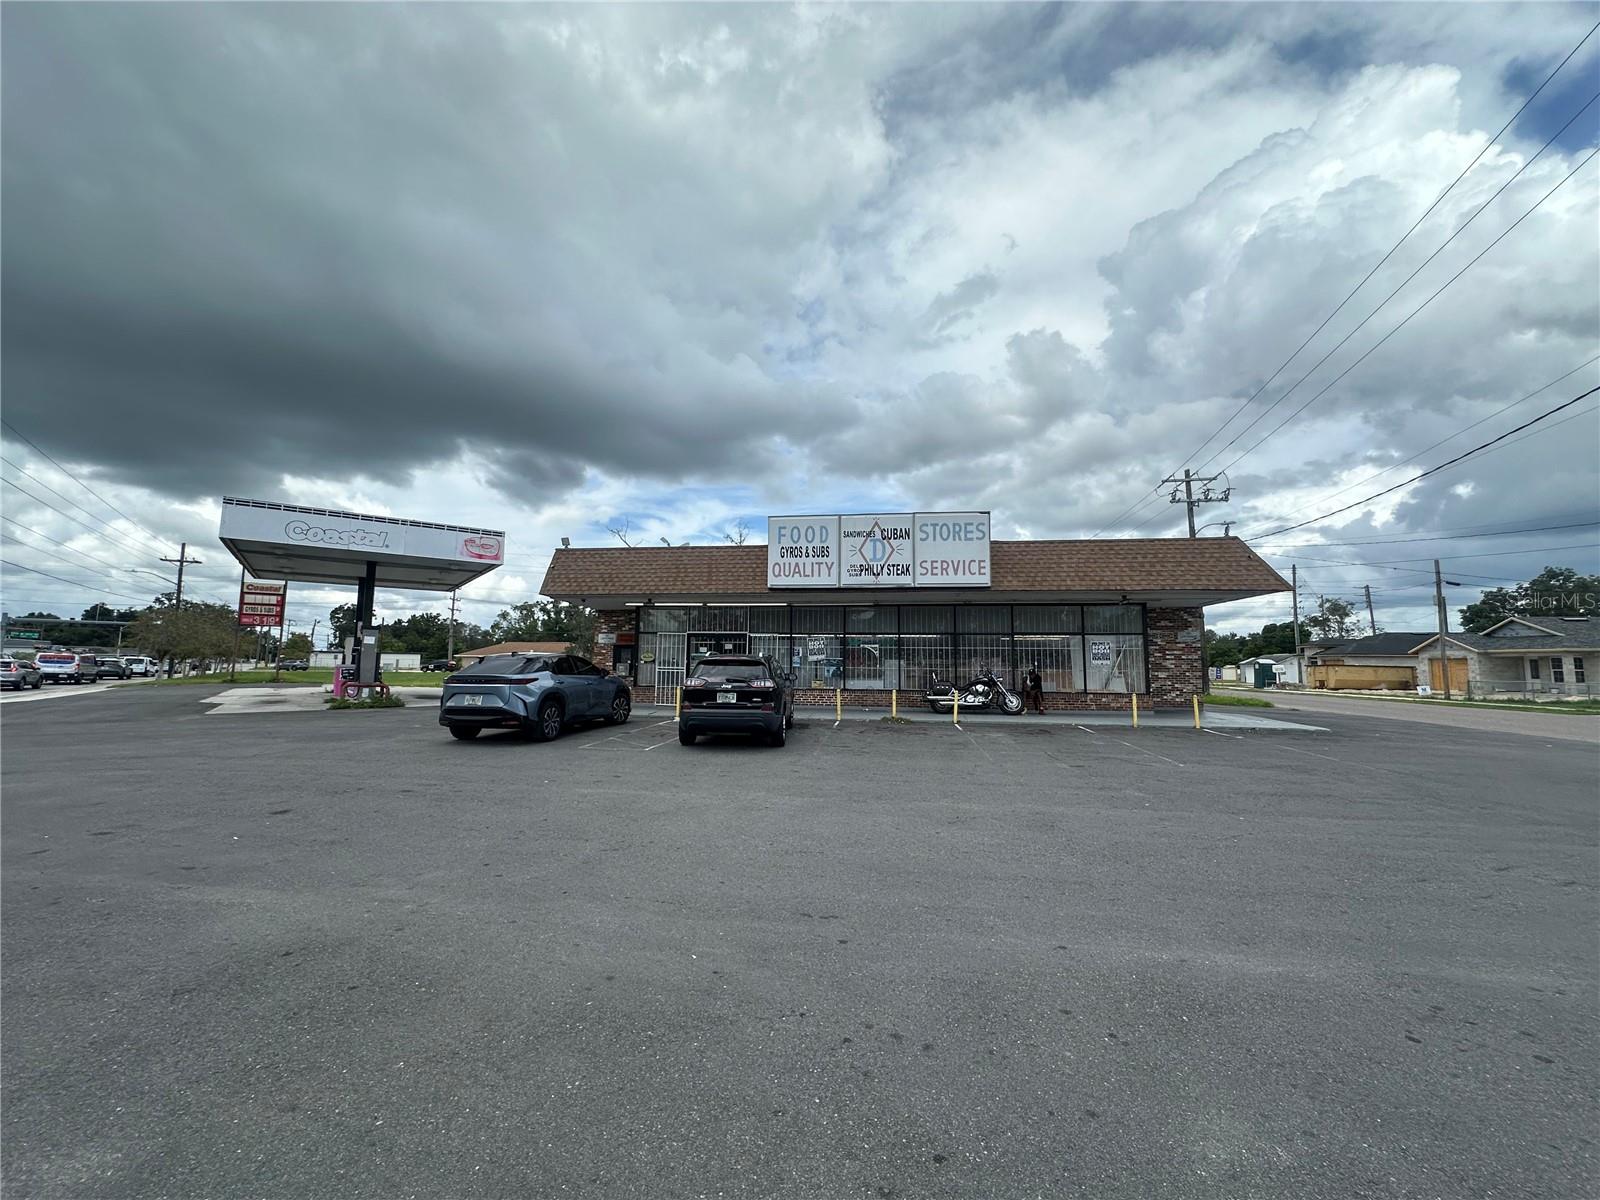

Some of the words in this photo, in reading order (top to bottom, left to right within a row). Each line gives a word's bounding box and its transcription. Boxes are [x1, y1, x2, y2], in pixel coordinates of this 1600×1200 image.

[285, 520, 388, 548] Coastal
[777, 525, 829, 544] FOOD
[843, 530, 876, 538] SANDWICHES
[880, 527, 910, 540] CUBAN
[919, 522, 986, 542] STORES
[780, 545, 803, 559] GYROS
[804, 545, 810, 558] &
[811, 545, 830, 558] SUBS
[869, 538, 886, 562] D
[772, 561, 834, 578] QUALITY
[859, 563, 884, 576] PHILLY
[886, 563, 911, 576] STEAK
[919, 559, 986, 576] SERVICE
